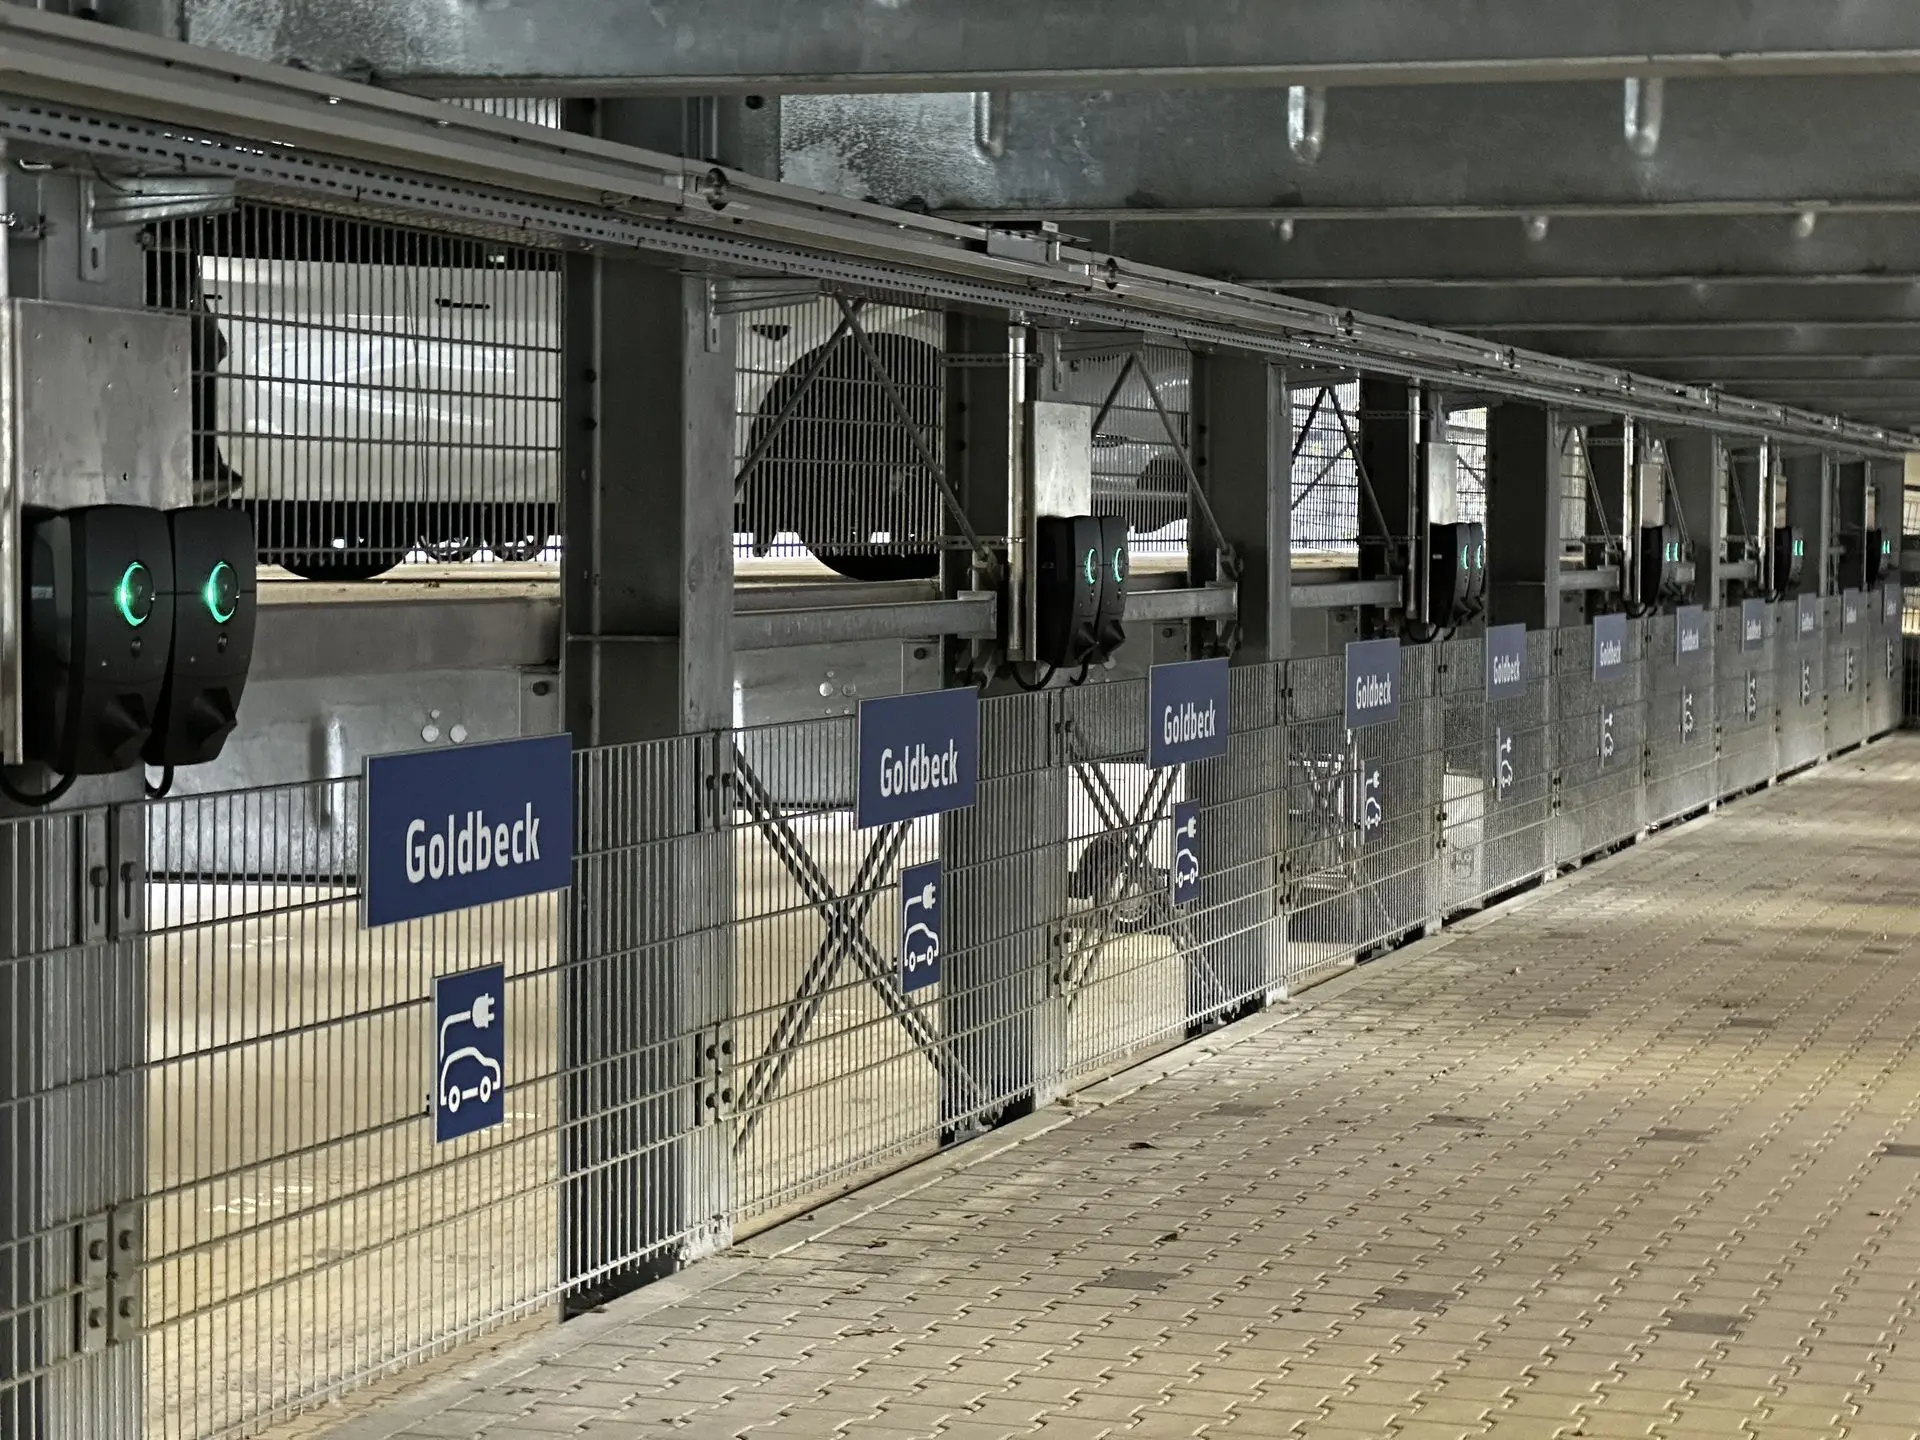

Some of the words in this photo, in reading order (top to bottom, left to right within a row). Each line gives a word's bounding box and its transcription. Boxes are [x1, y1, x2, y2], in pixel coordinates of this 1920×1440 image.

[1355, 672, 1392, 710] Goldbeck
[1493, 652, 1521, 685] Goldbeck
[1164, 699, 1216, 745] Goldbeck
[880, 738, 958, 798] Goldbeck
[406, 802, 540, 884] Goldbeck
